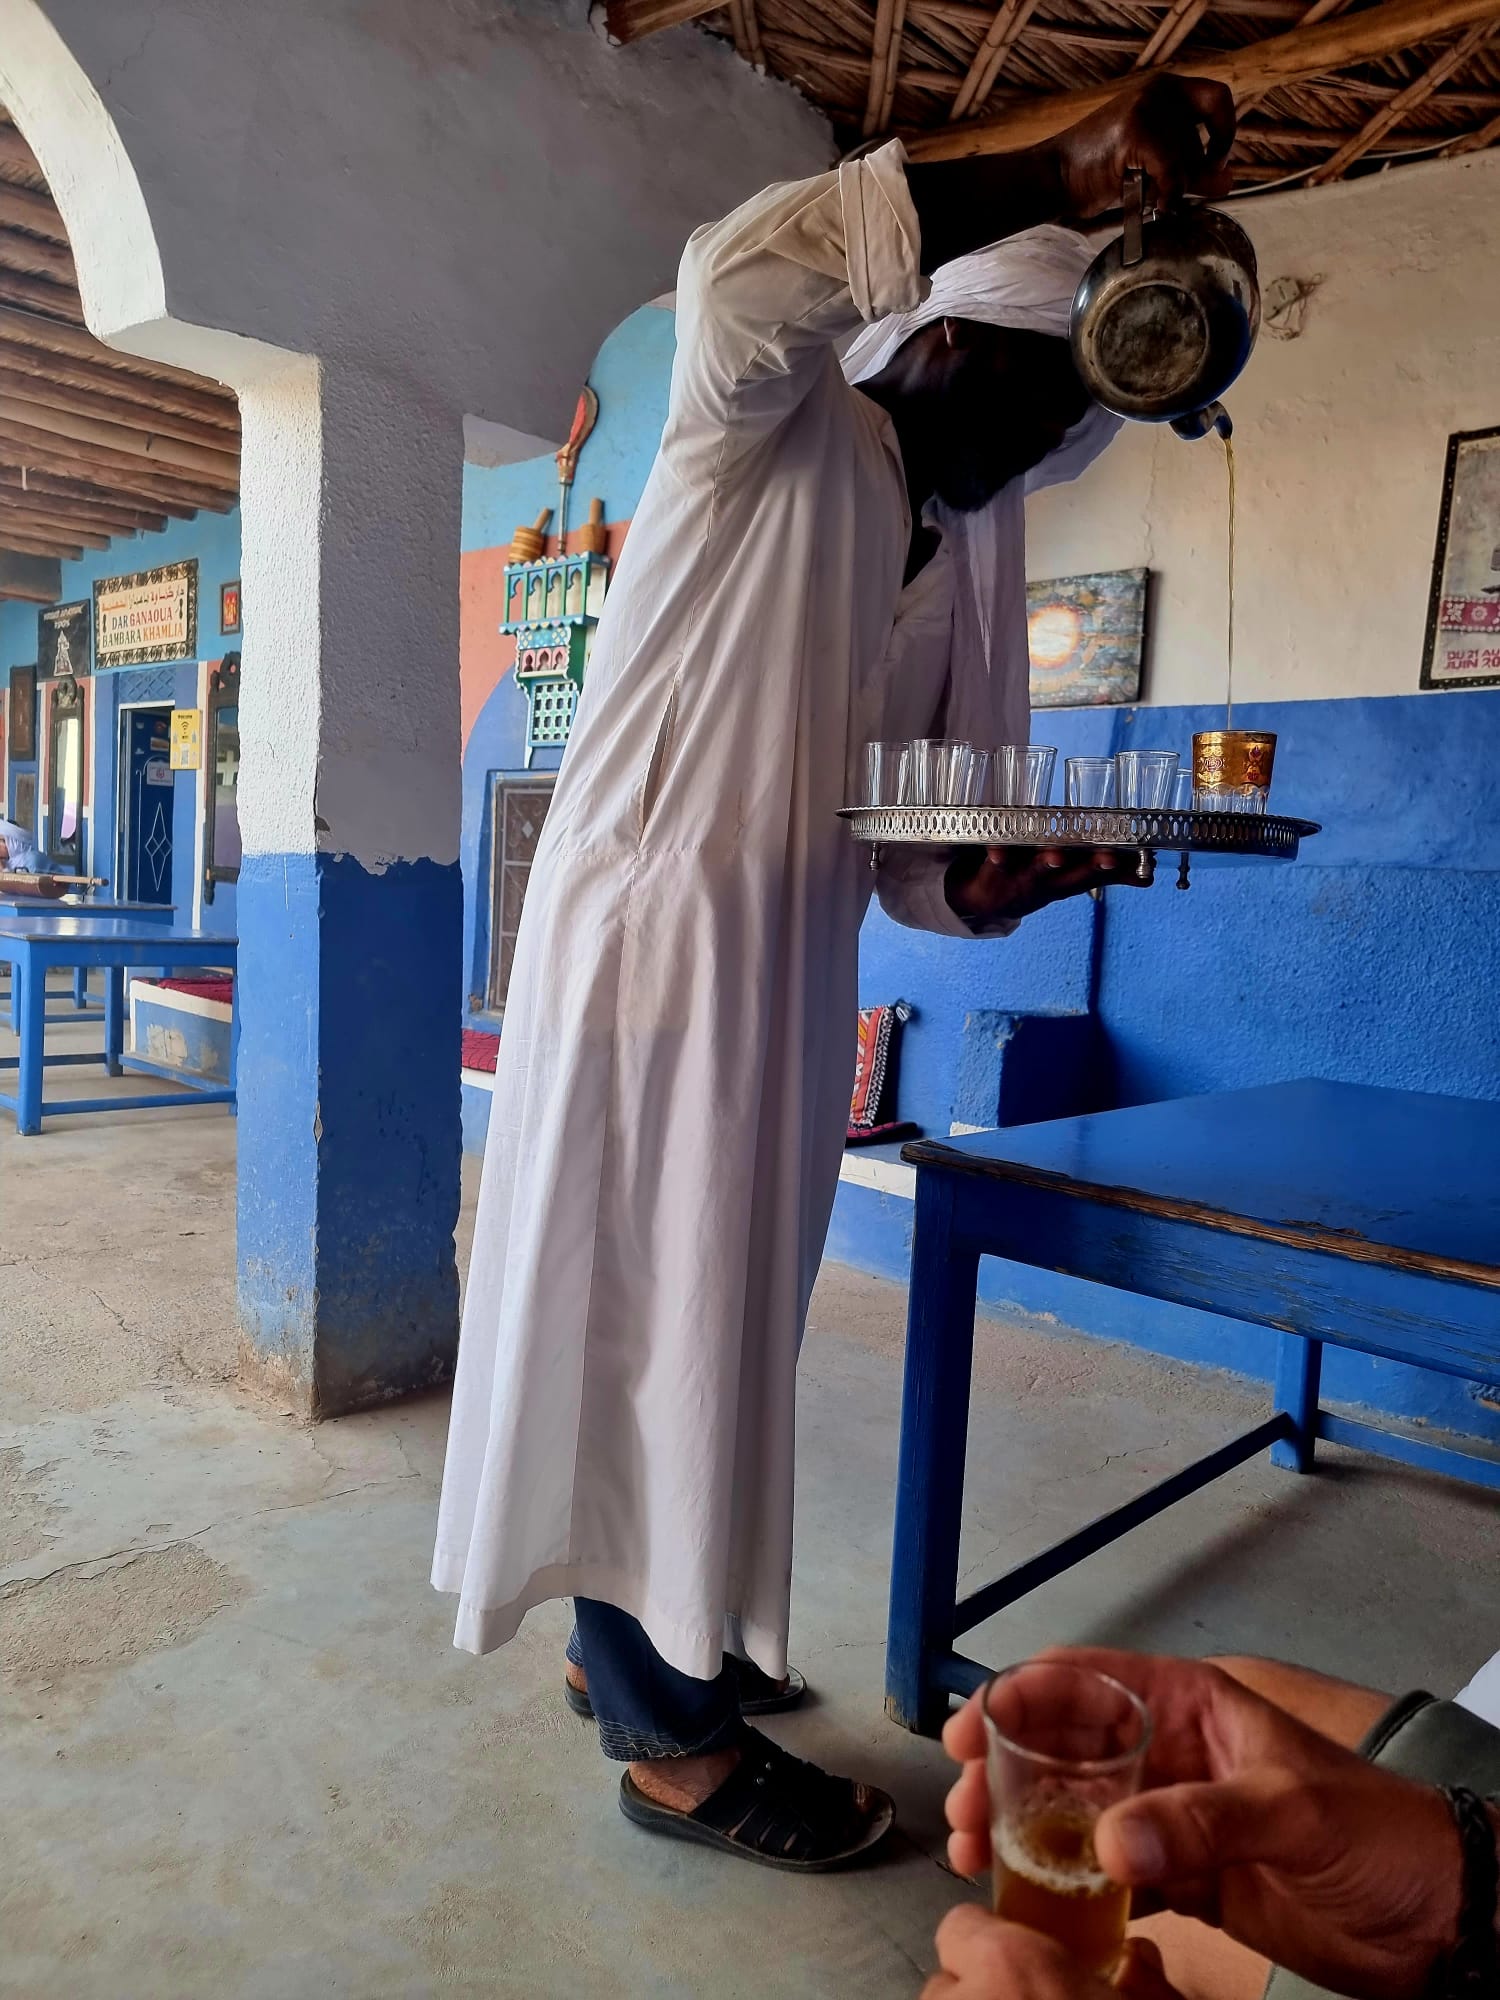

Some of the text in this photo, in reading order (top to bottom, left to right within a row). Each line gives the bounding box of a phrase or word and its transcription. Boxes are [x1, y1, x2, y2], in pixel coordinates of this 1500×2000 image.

[112, 606, 173, 630] DAR GANAOUA
[102, 622, 184, 648] BAMBARA KHAMLIA
[1447, 650, 1465, 660] DU
[1444, 659, 1479, 670] JUIN
